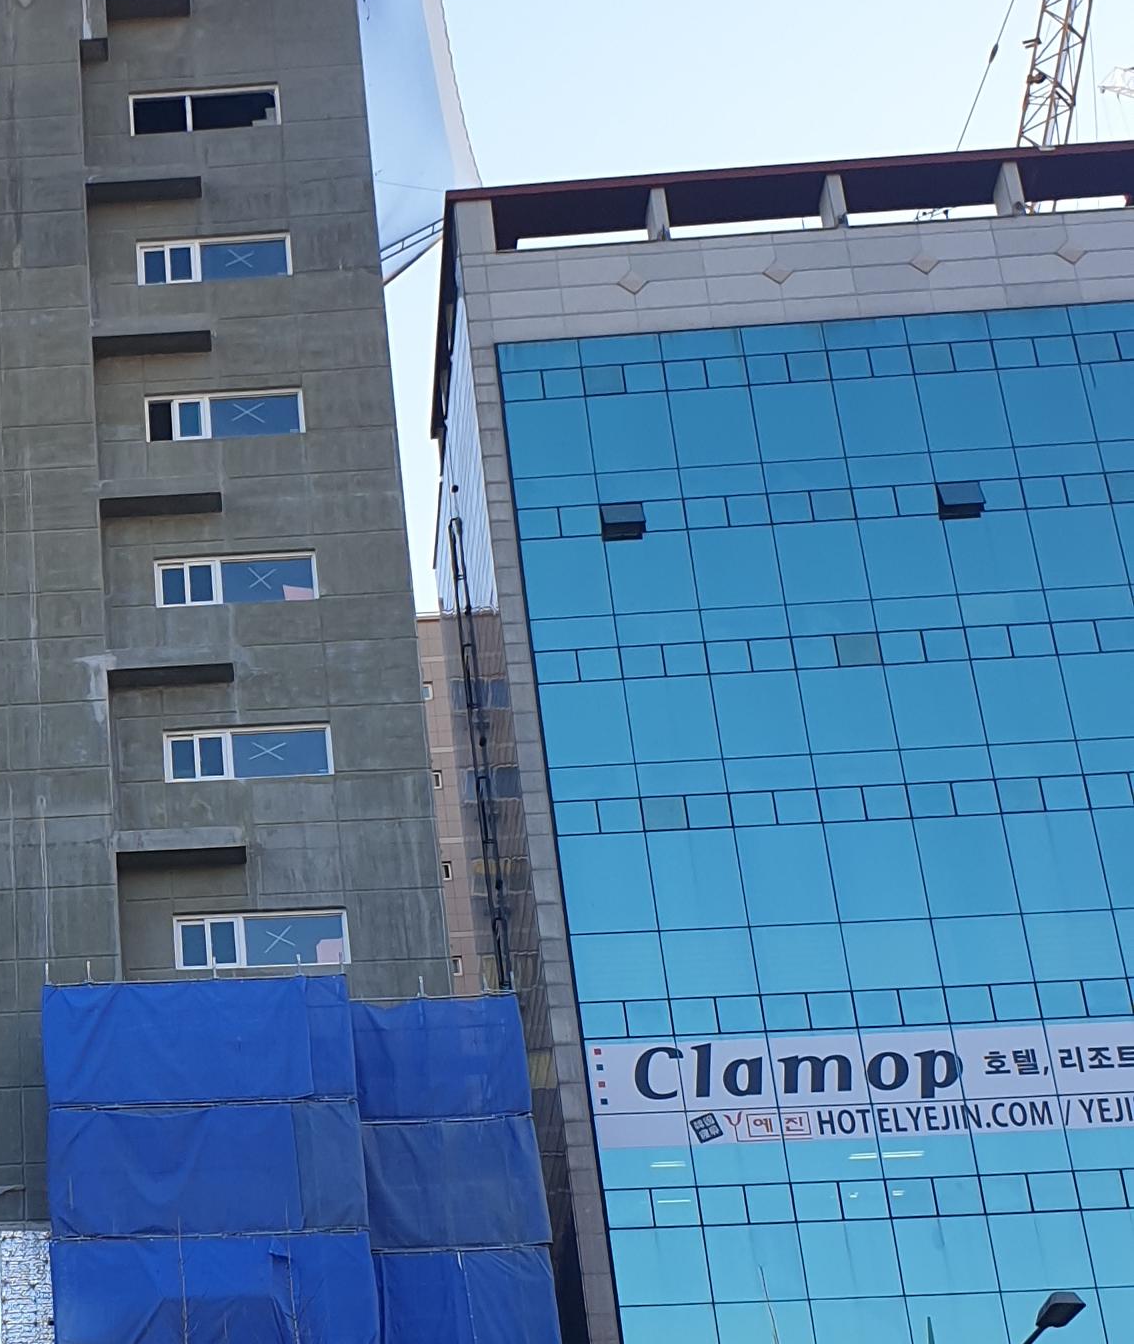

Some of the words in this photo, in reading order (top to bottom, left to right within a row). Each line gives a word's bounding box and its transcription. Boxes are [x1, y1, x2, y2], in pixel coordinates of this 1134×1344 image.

[634, 1043, 964, 1099] Clamop
[983, 1048, 1049, 1076] 호텔,
[817, 1099, 1053, 1136] HOTELYEJIN.COM
[1078, 1096, 1134, 1124] YEJI
